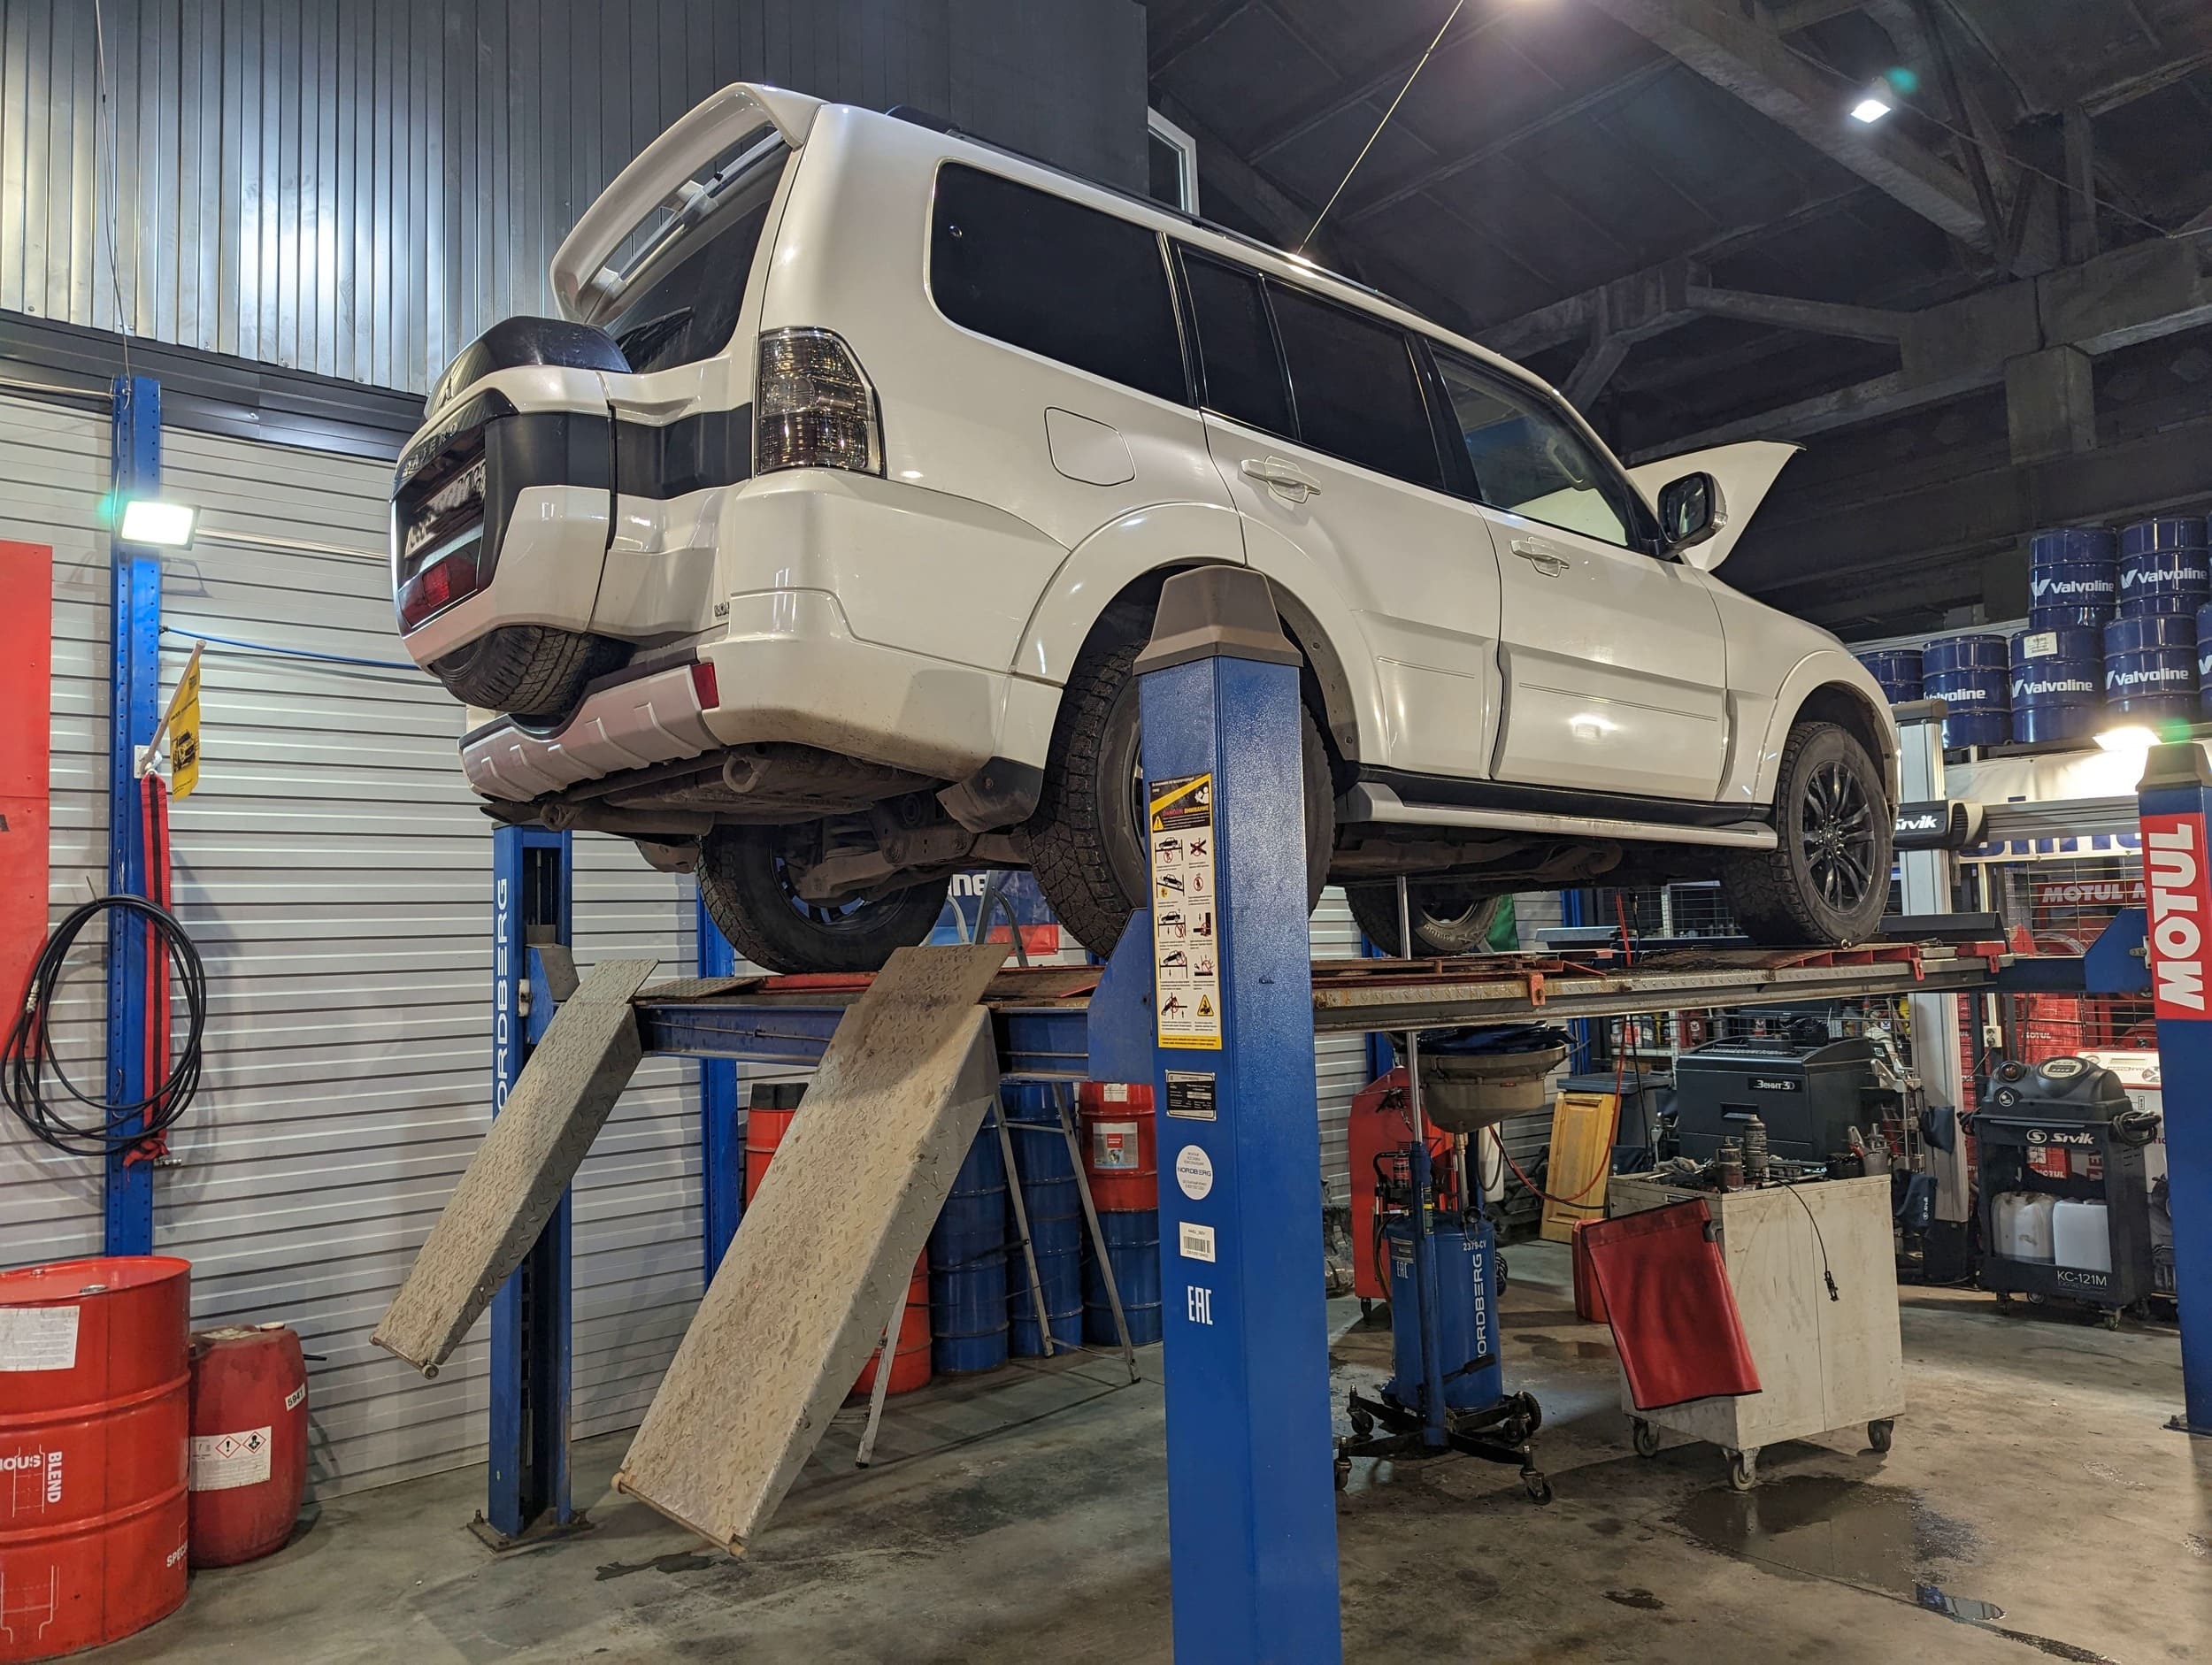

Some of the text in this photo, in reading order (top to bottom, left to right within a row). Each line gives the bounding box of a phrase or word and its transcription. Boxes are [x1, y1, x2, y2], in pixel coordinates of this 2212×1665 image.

[2137, 567, 2208, 584] Valvoline
[2050, 579, 2115, 594] Valvoline
[2023, 679, 2093, 694] Valvoline
[2115, 668, 2189, 687] Valvoline
[949, 873, 987, 897] ne
[2042, 884, 2124, 902] MOTUL
[2148, 823, 2205, 1011] MOTUL
[496, 878, 509, 1111] ORDBERG
[2050, 1132, 2095, 1145] Sivik
[1178, 1166, 1211, 1177] NORDBERG
[1187, 1285, 1213, 1325] EAC
[1472, 1254, 1487, 1358] ORDBERG
[288, 1389, 303, 1407] 5941
[47, 1451, 63, 1503] BLEND
